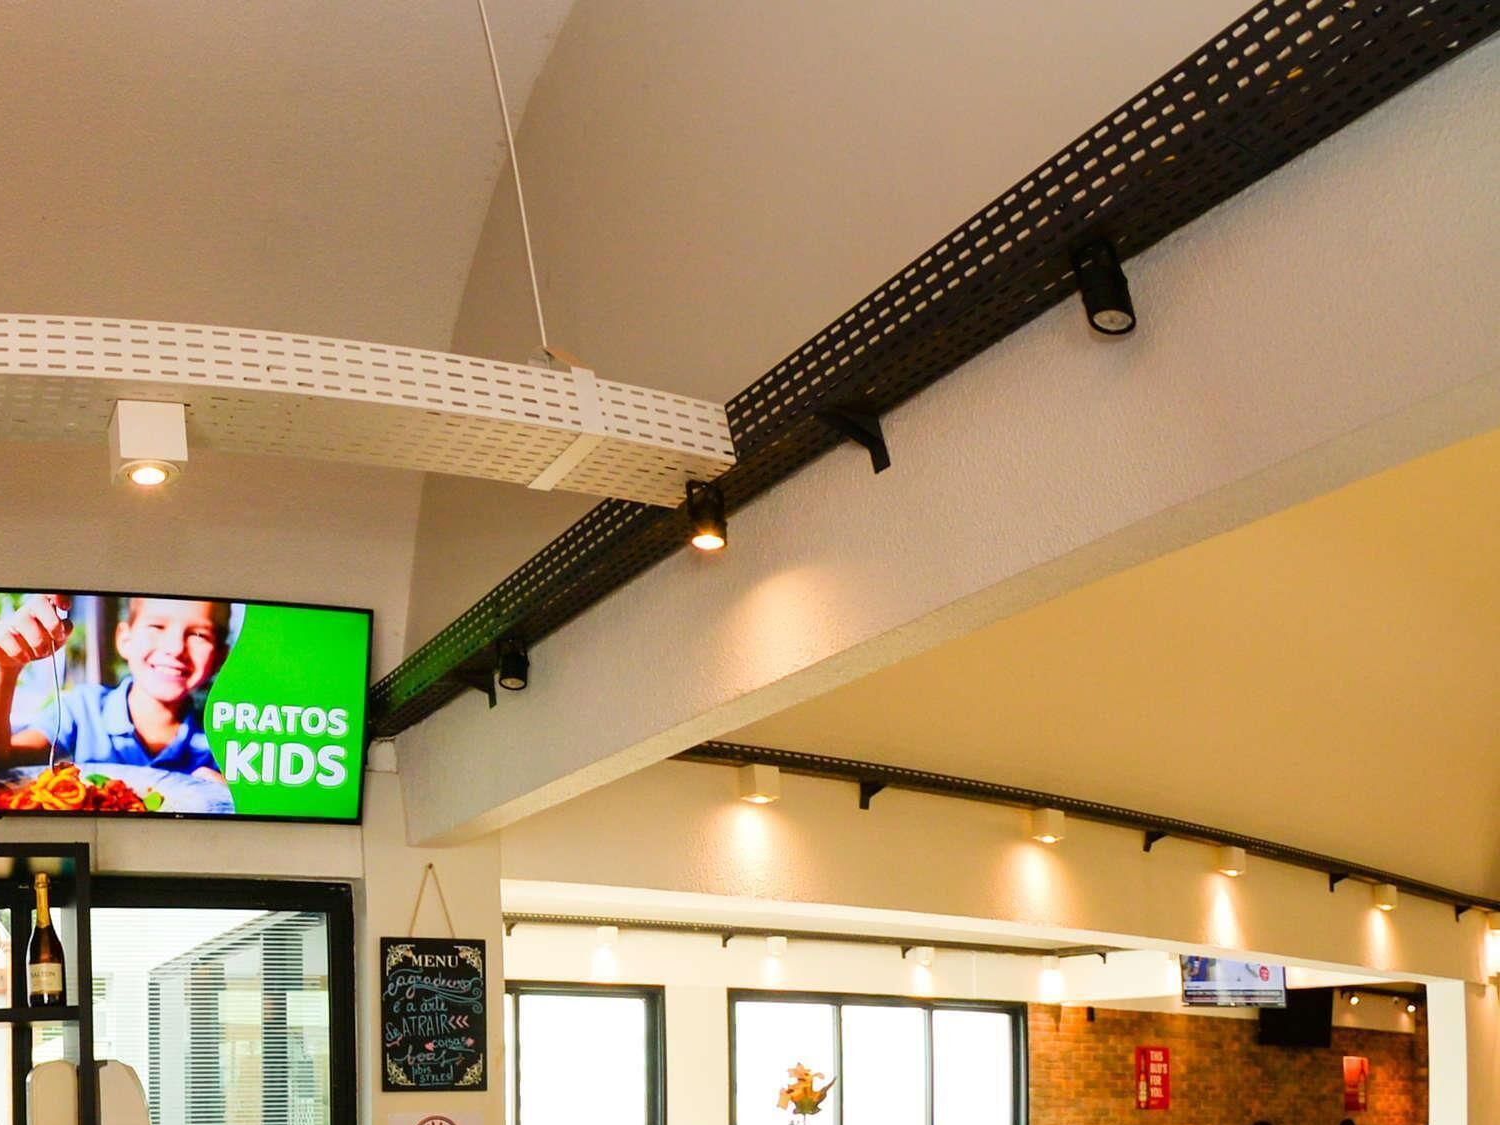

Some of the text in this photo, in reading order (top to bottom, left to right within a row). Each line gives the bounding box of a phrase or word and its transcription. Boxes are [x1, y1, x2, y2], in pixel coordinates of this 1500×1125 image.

[212, 701, 348, 737] PRATOS
[225, 740, 348, 787] KIDS
[411, 954, 459, 968] MENU
[406, 1002, 417, 1012] a
